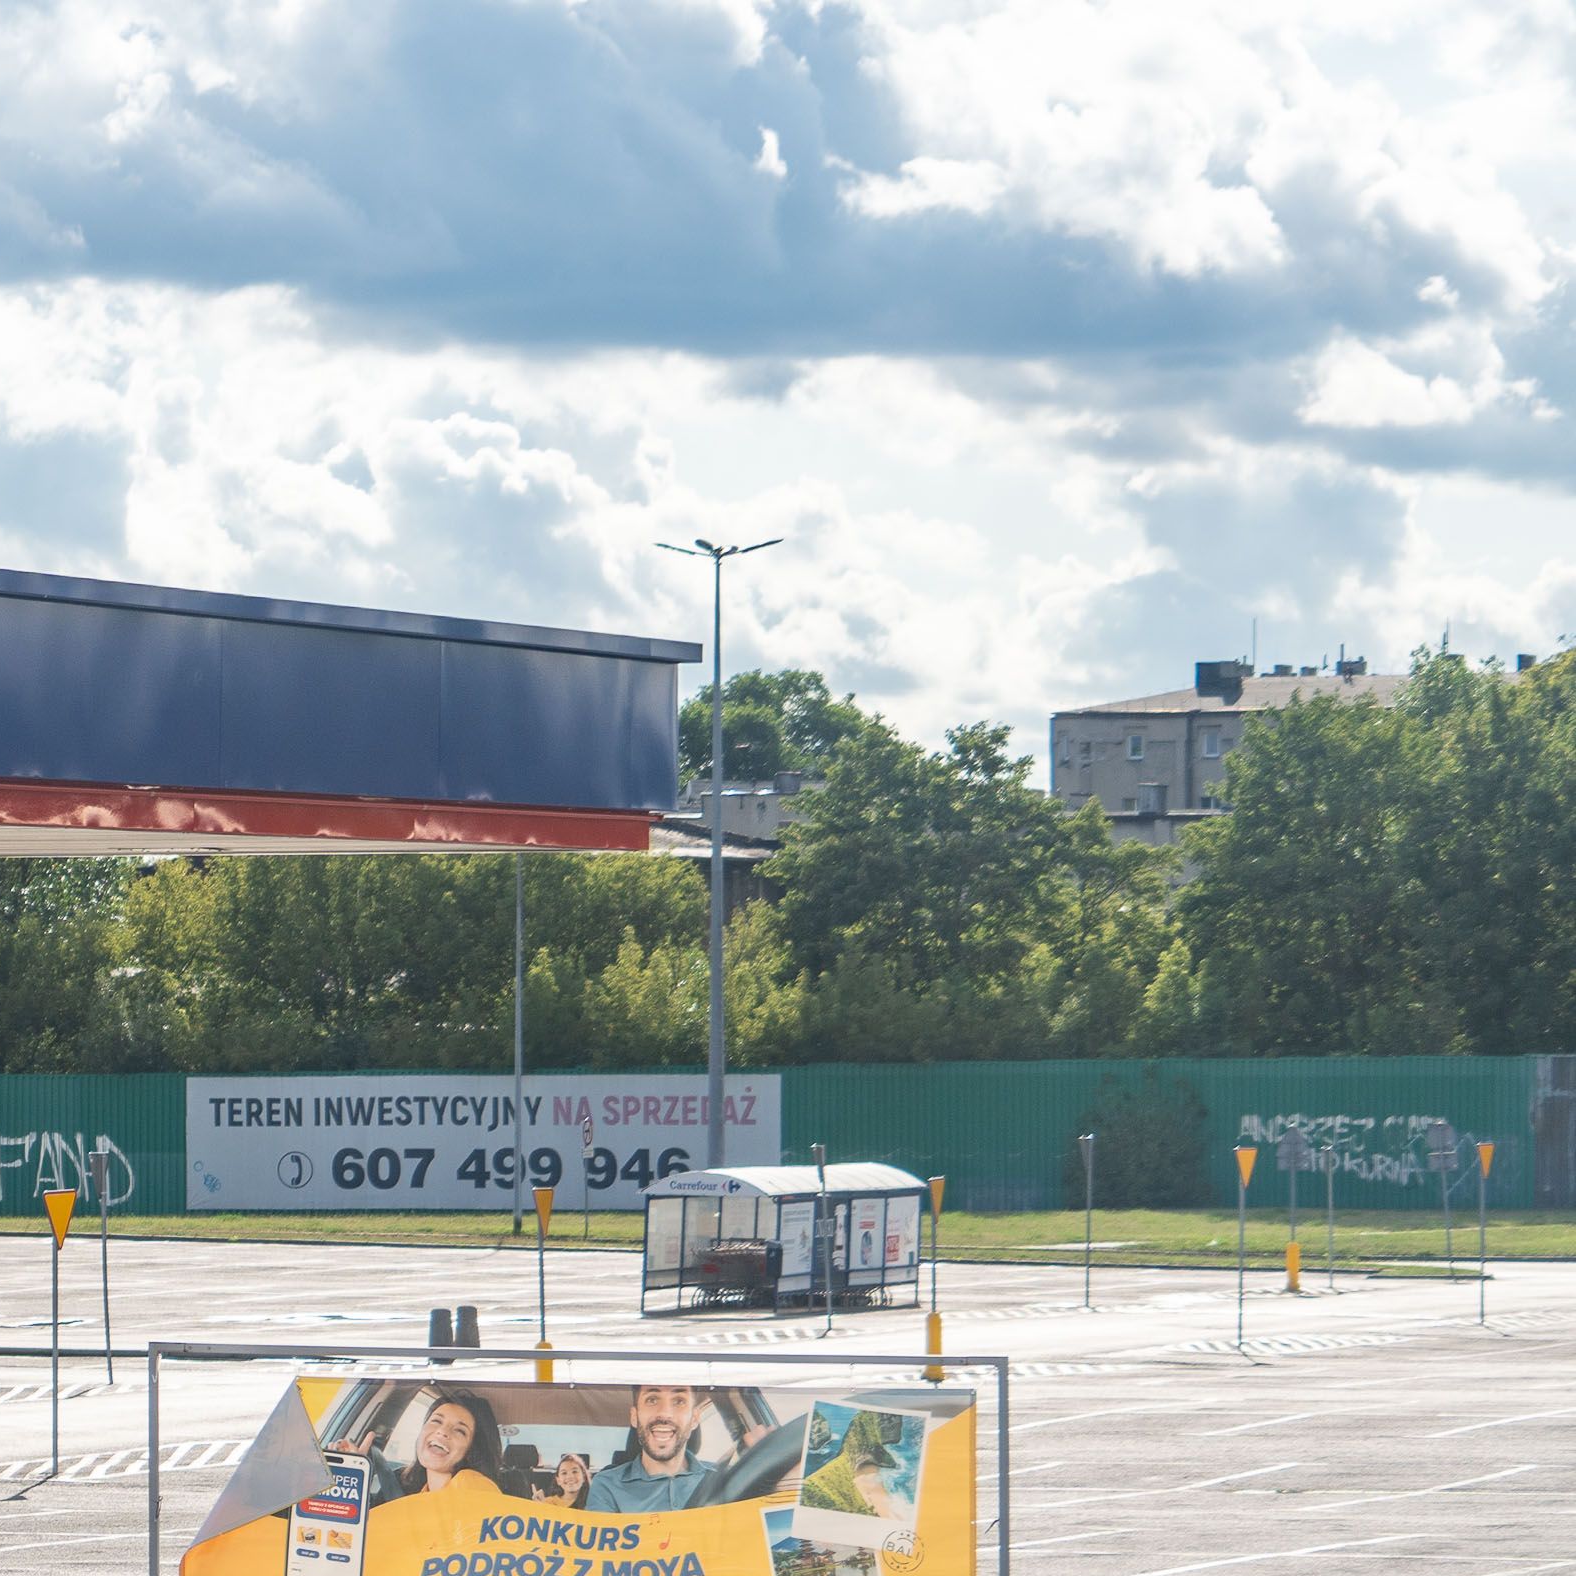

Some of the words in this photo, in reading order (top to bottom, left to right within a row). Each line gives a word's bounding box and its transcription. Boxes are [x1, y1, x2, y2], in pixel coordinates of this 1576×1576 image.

[209, 1096, 304, 1127] TEREN
[313, 1096, 543, 1133] INWESTYCYJNY
[552, 1096, 592, 1125] NA
[331, 1148, 436, 1189] 607
[456, 1148, 563, 1189] 499
[583, 1148, 692, 1189] 946
[670, 1180, 719, 1191] Carrefour
[333, 1475, 359, 1488] PER
[478, 1515, 641, 1551] KONKURS
[886, 1541, 920, 1561] BALI
